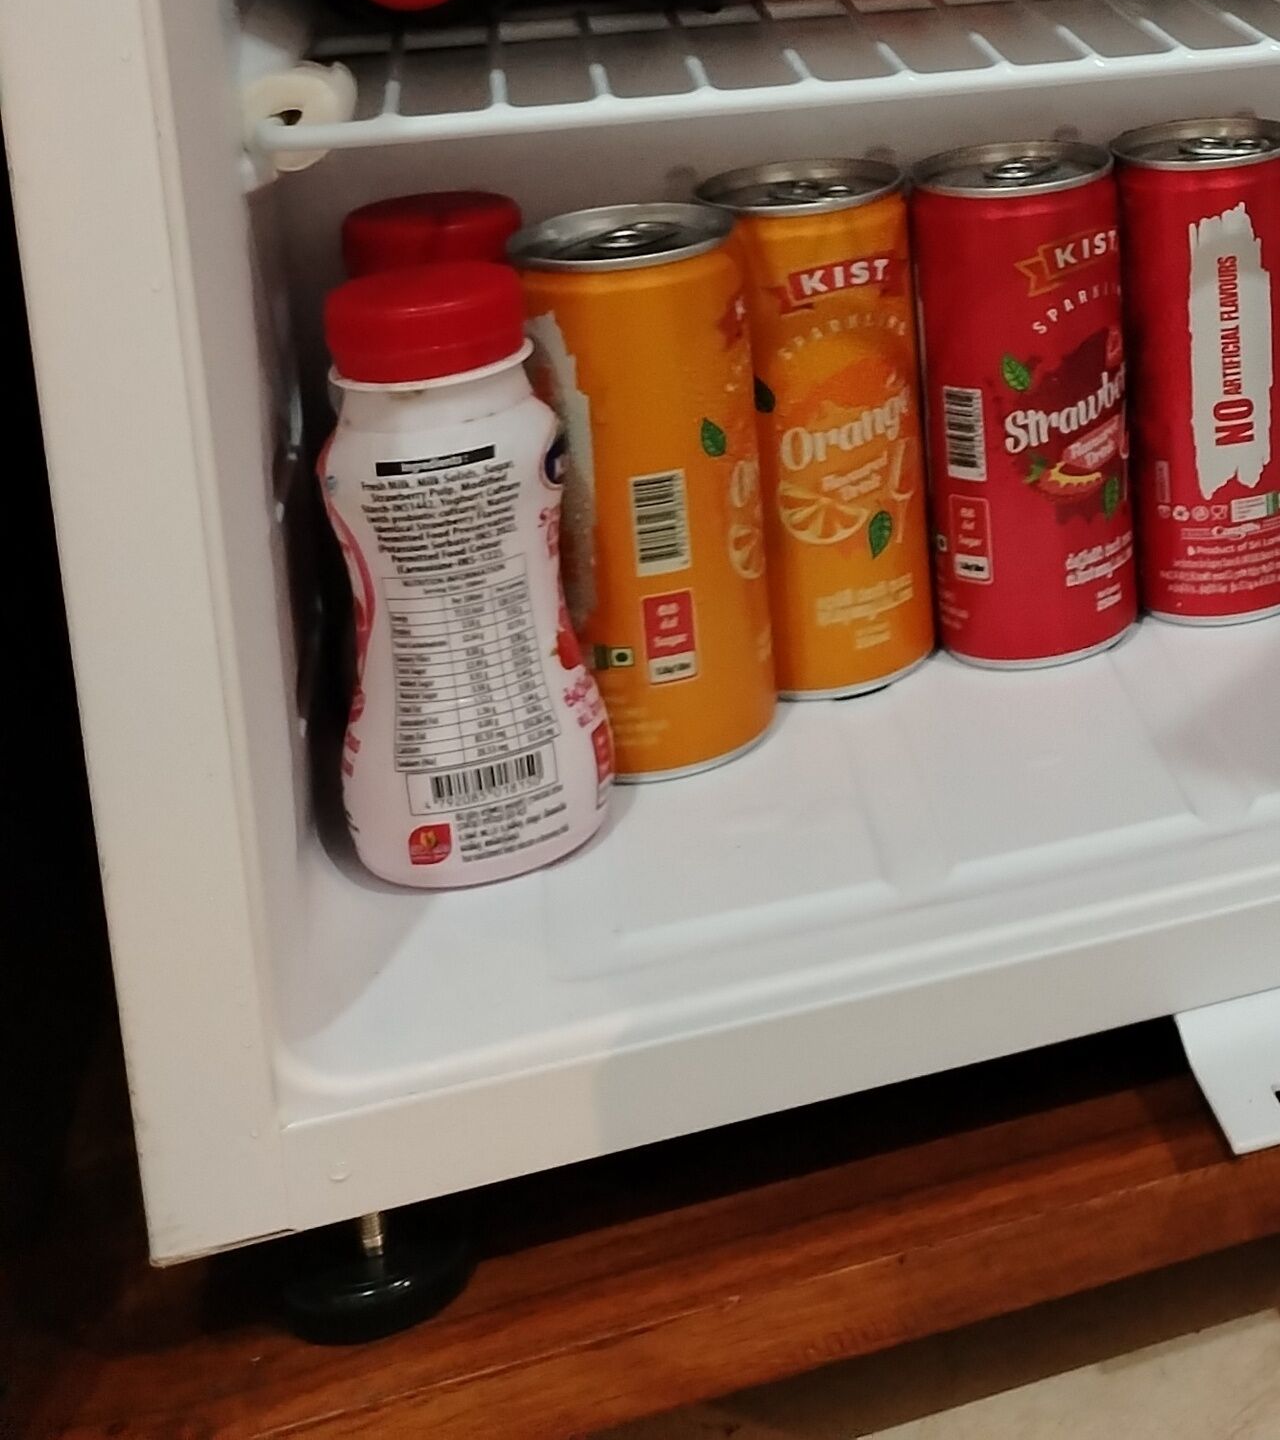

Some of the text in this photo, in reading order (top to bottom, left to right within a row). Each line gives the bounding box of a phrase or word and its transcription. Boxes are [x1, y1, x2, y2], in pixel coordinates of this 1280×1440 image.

[1054, 229, 1119, 269] KIST
[799, 258, 890, 297] KIST
[1213, 255, 1255, 446] NO ARTIFICIAL FLAVOURS
